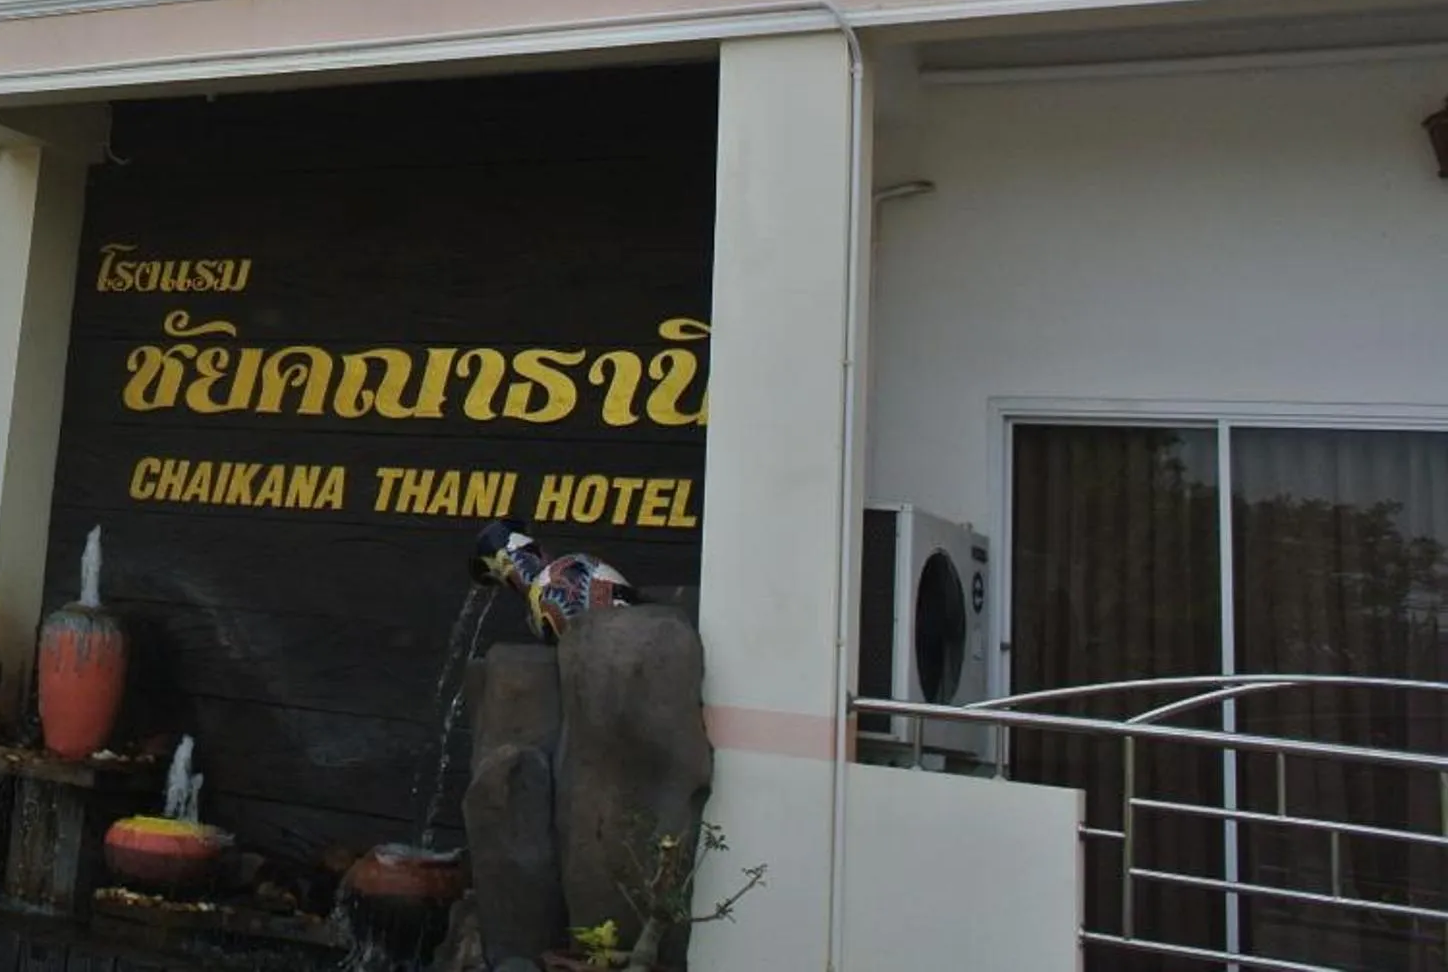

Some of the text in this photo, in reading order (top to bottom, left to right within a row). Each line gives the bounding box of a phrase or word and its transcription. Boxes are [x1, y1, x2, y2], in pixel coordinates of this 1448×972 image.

[96, 242, 252, 293] โรงแรม
[129, 456, 698, 528] CHAIKANA THANI HOTEL
